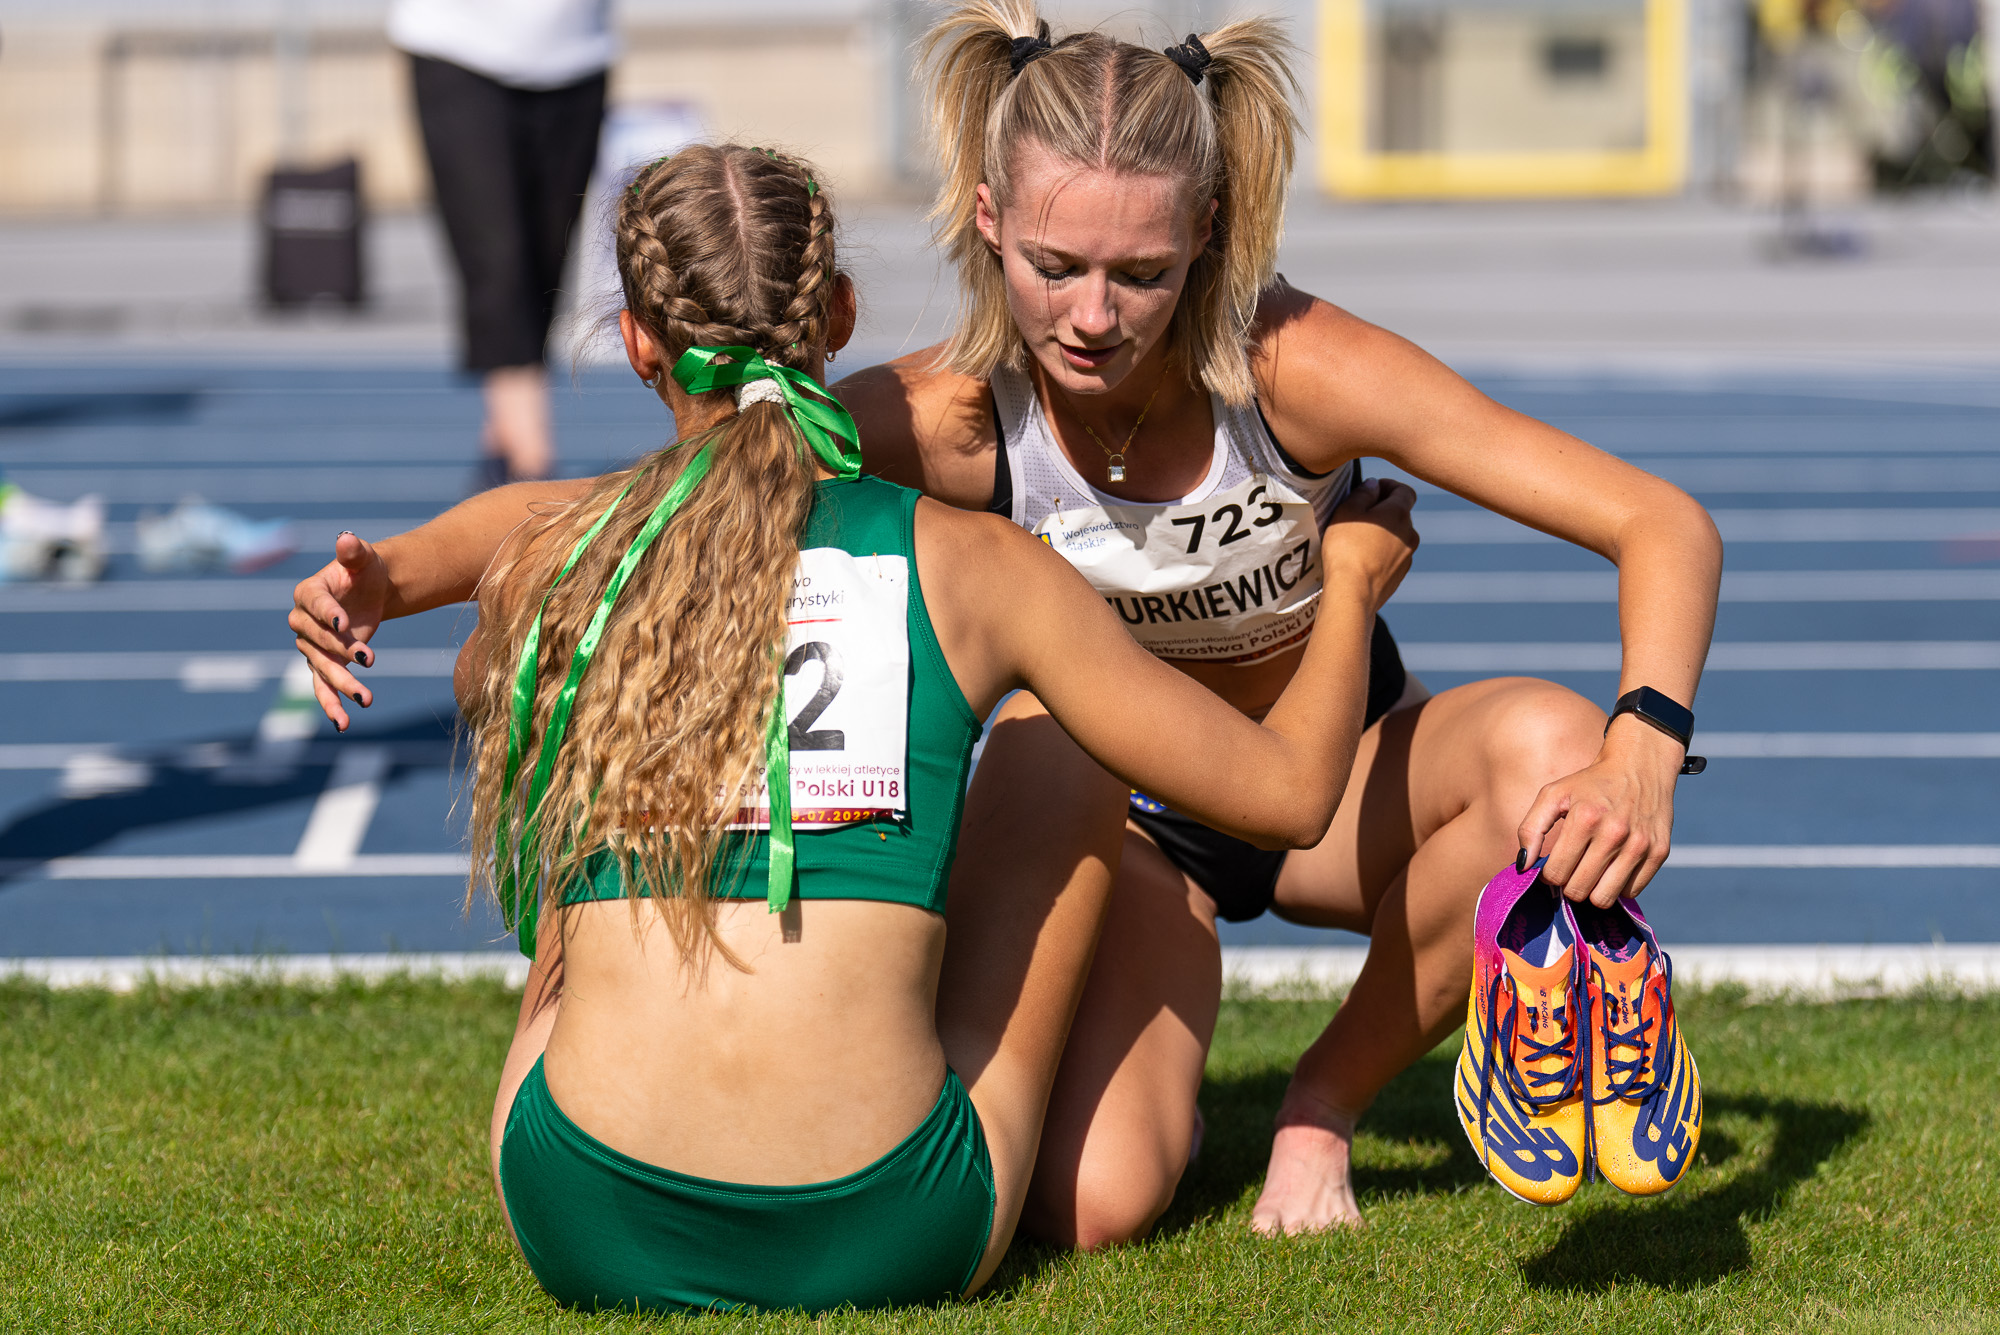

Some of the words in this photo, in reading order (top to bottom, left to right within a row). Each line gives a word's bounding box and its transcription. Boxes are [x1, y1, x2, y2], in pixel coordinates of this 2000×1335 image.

[1171, 485, 1284, 554] 723
[1062, 521, 1139, 541] Województwo
[1250, 618, 1302, 647] Polski
[803, 767, 813, 775] w
[816, 764, 851, 777] lekkiej
[854, 764, 900, 777] atletyce
[796, 780, 854, 797] Polski
[862, 780, 899, 798] U18
